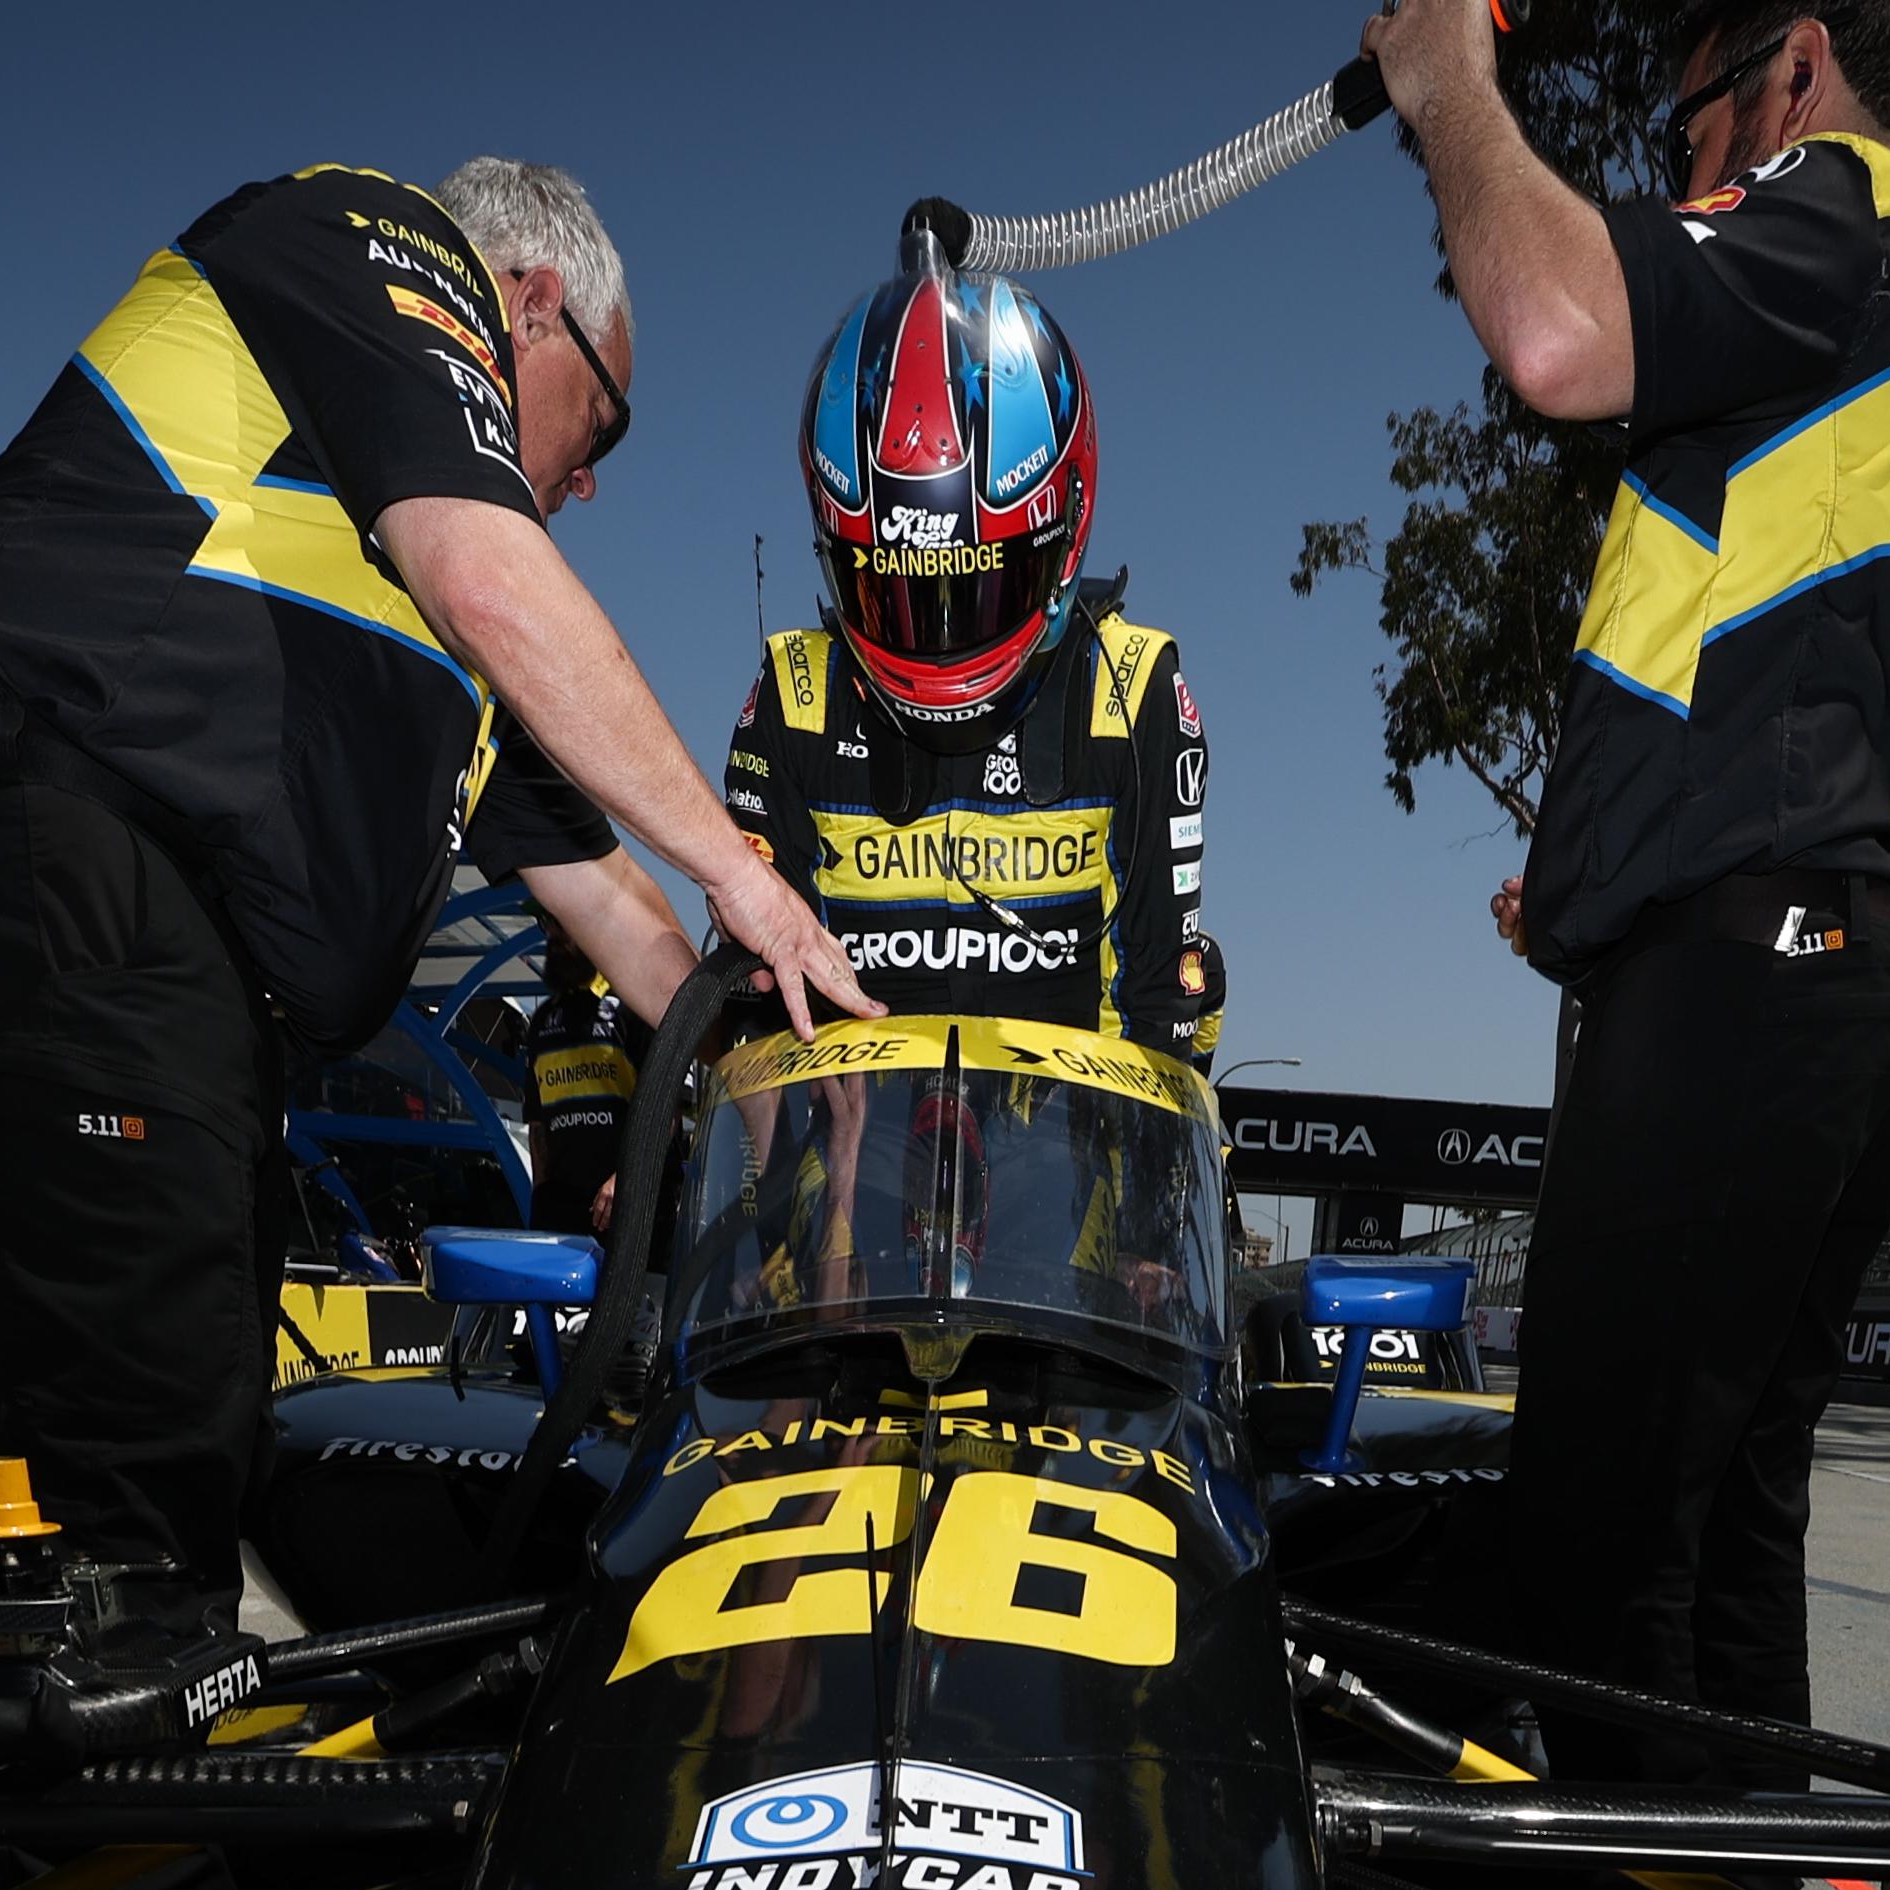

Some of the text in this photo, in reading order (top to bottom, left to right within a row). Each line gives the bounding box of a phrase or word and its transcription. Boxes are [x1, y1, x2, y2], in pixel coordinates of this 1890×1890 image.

[995, 444, 1049, 497] MOCKETT
[880, 504, 960, 542] King
[872, 541, 1005, 577] GAINBRIDGE
[1105, 634, 1144, 717] sparco
[895, 702, 997, 724] HONDA
[835, 741, 869, 759] HO
[983, 768, 1021, 796] 100
[1178, 823, 1201, 838] SIEM
[855, 829, 1097, 882] GAINBRIDGE
[842, 927, 1079, 974] GROUP1001
[77, 1114, 122, 1137] 5.11
[1472, 1135, 1545, 1168] AC
[1342, 1237, 1394, 1251] ACURA
[320, 1436, 524, 1471] Firesto
[661, 1413, 1196, 1496] GAINBRIDGE
[604, 1465, 1179, 1686] 26
[184, 1654, 261, 1727] HERTA
[873, 1798, 1049, 1848] NTT
